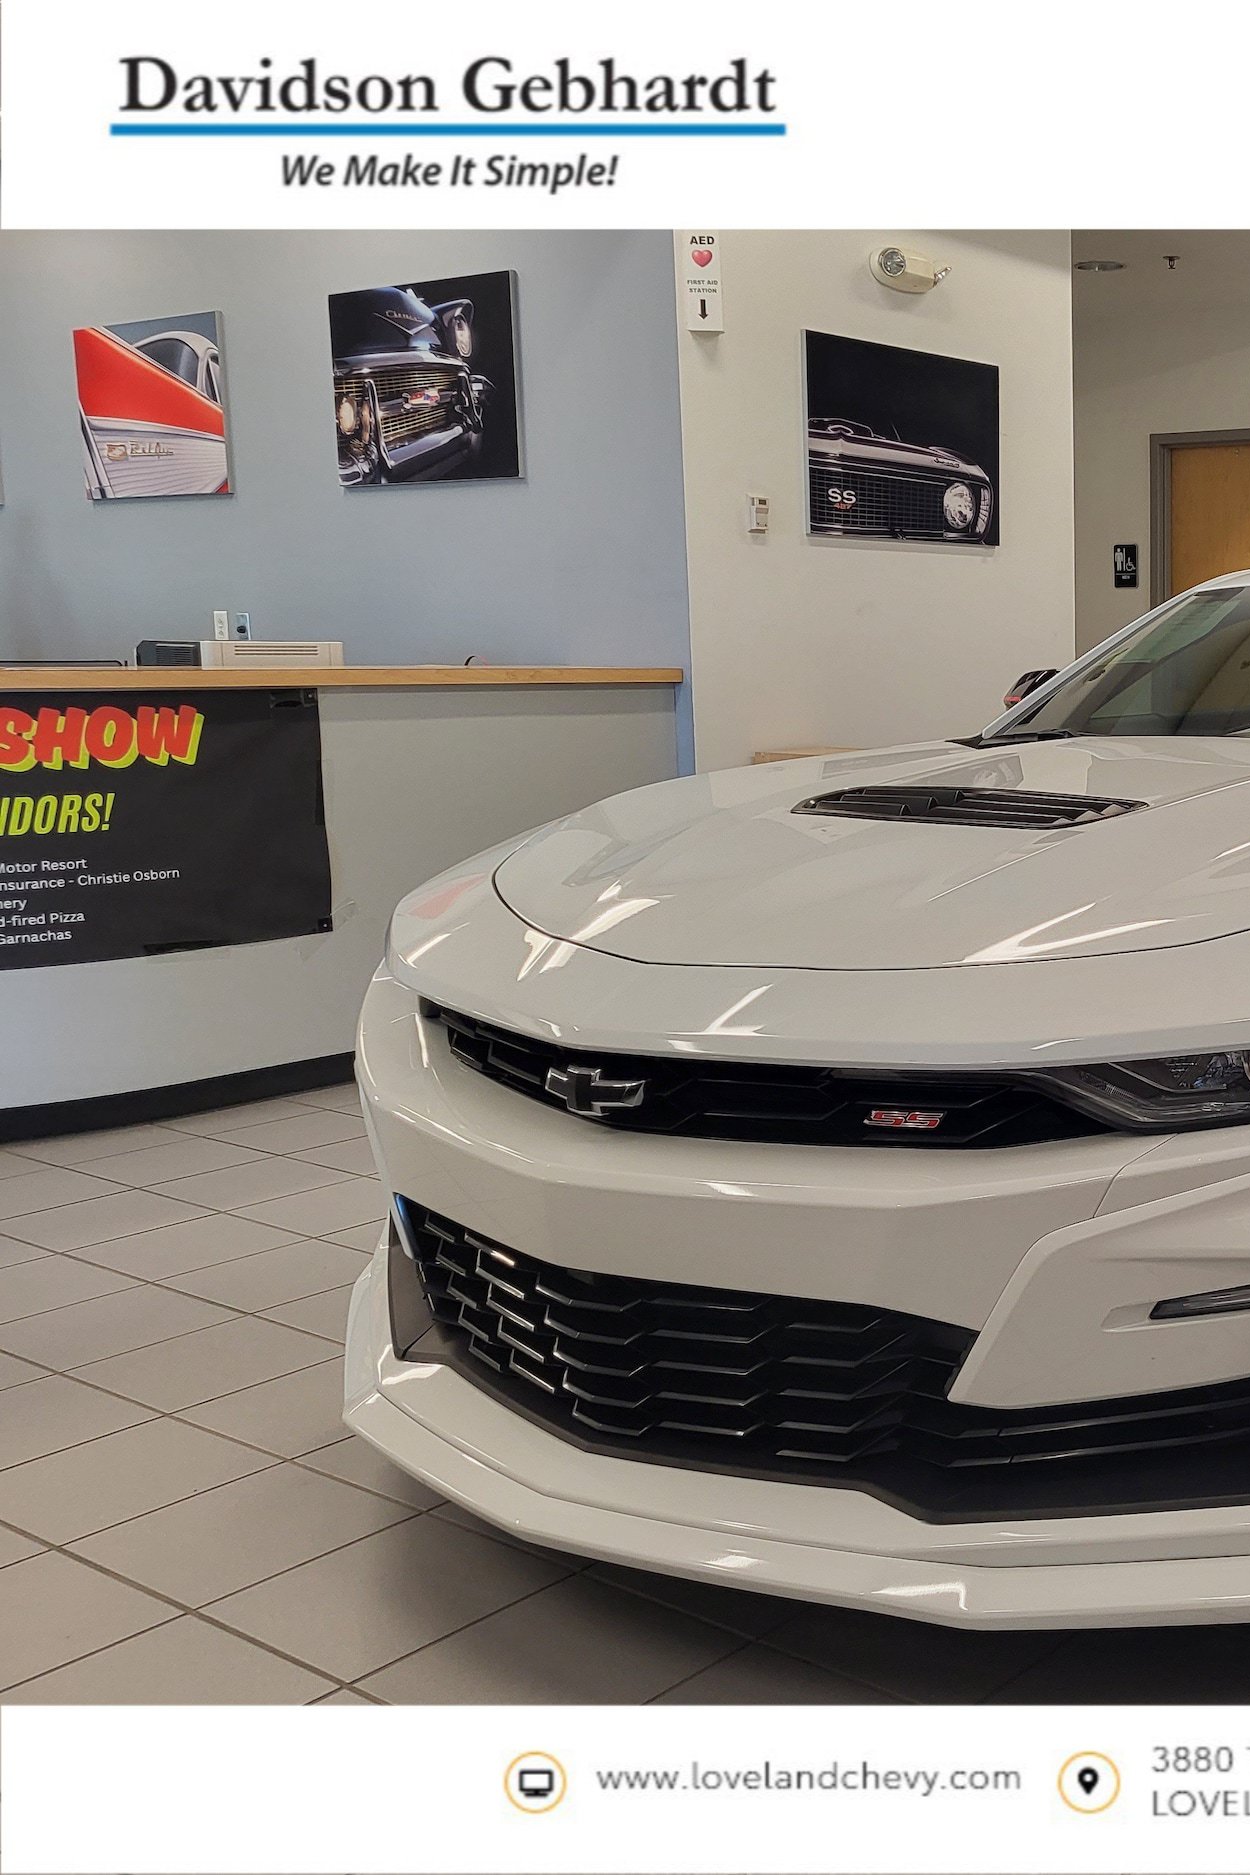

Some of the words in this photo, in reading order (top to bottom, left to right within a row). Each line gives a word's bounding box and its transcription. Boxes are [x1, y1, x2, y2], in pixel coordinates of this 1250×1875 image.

[690, 236, 714, 245] AED
[827, 487, 857, 504] SS
[0, 705, 205, 772] SHOW
[41, 859, 88, 872] Resort
[77, 872, 131, 887] Christie
[133, 869, 180, 882] Osborn
[50, 912, 86, 924] Pizza
[862, 1109, 945, 1129] SS
